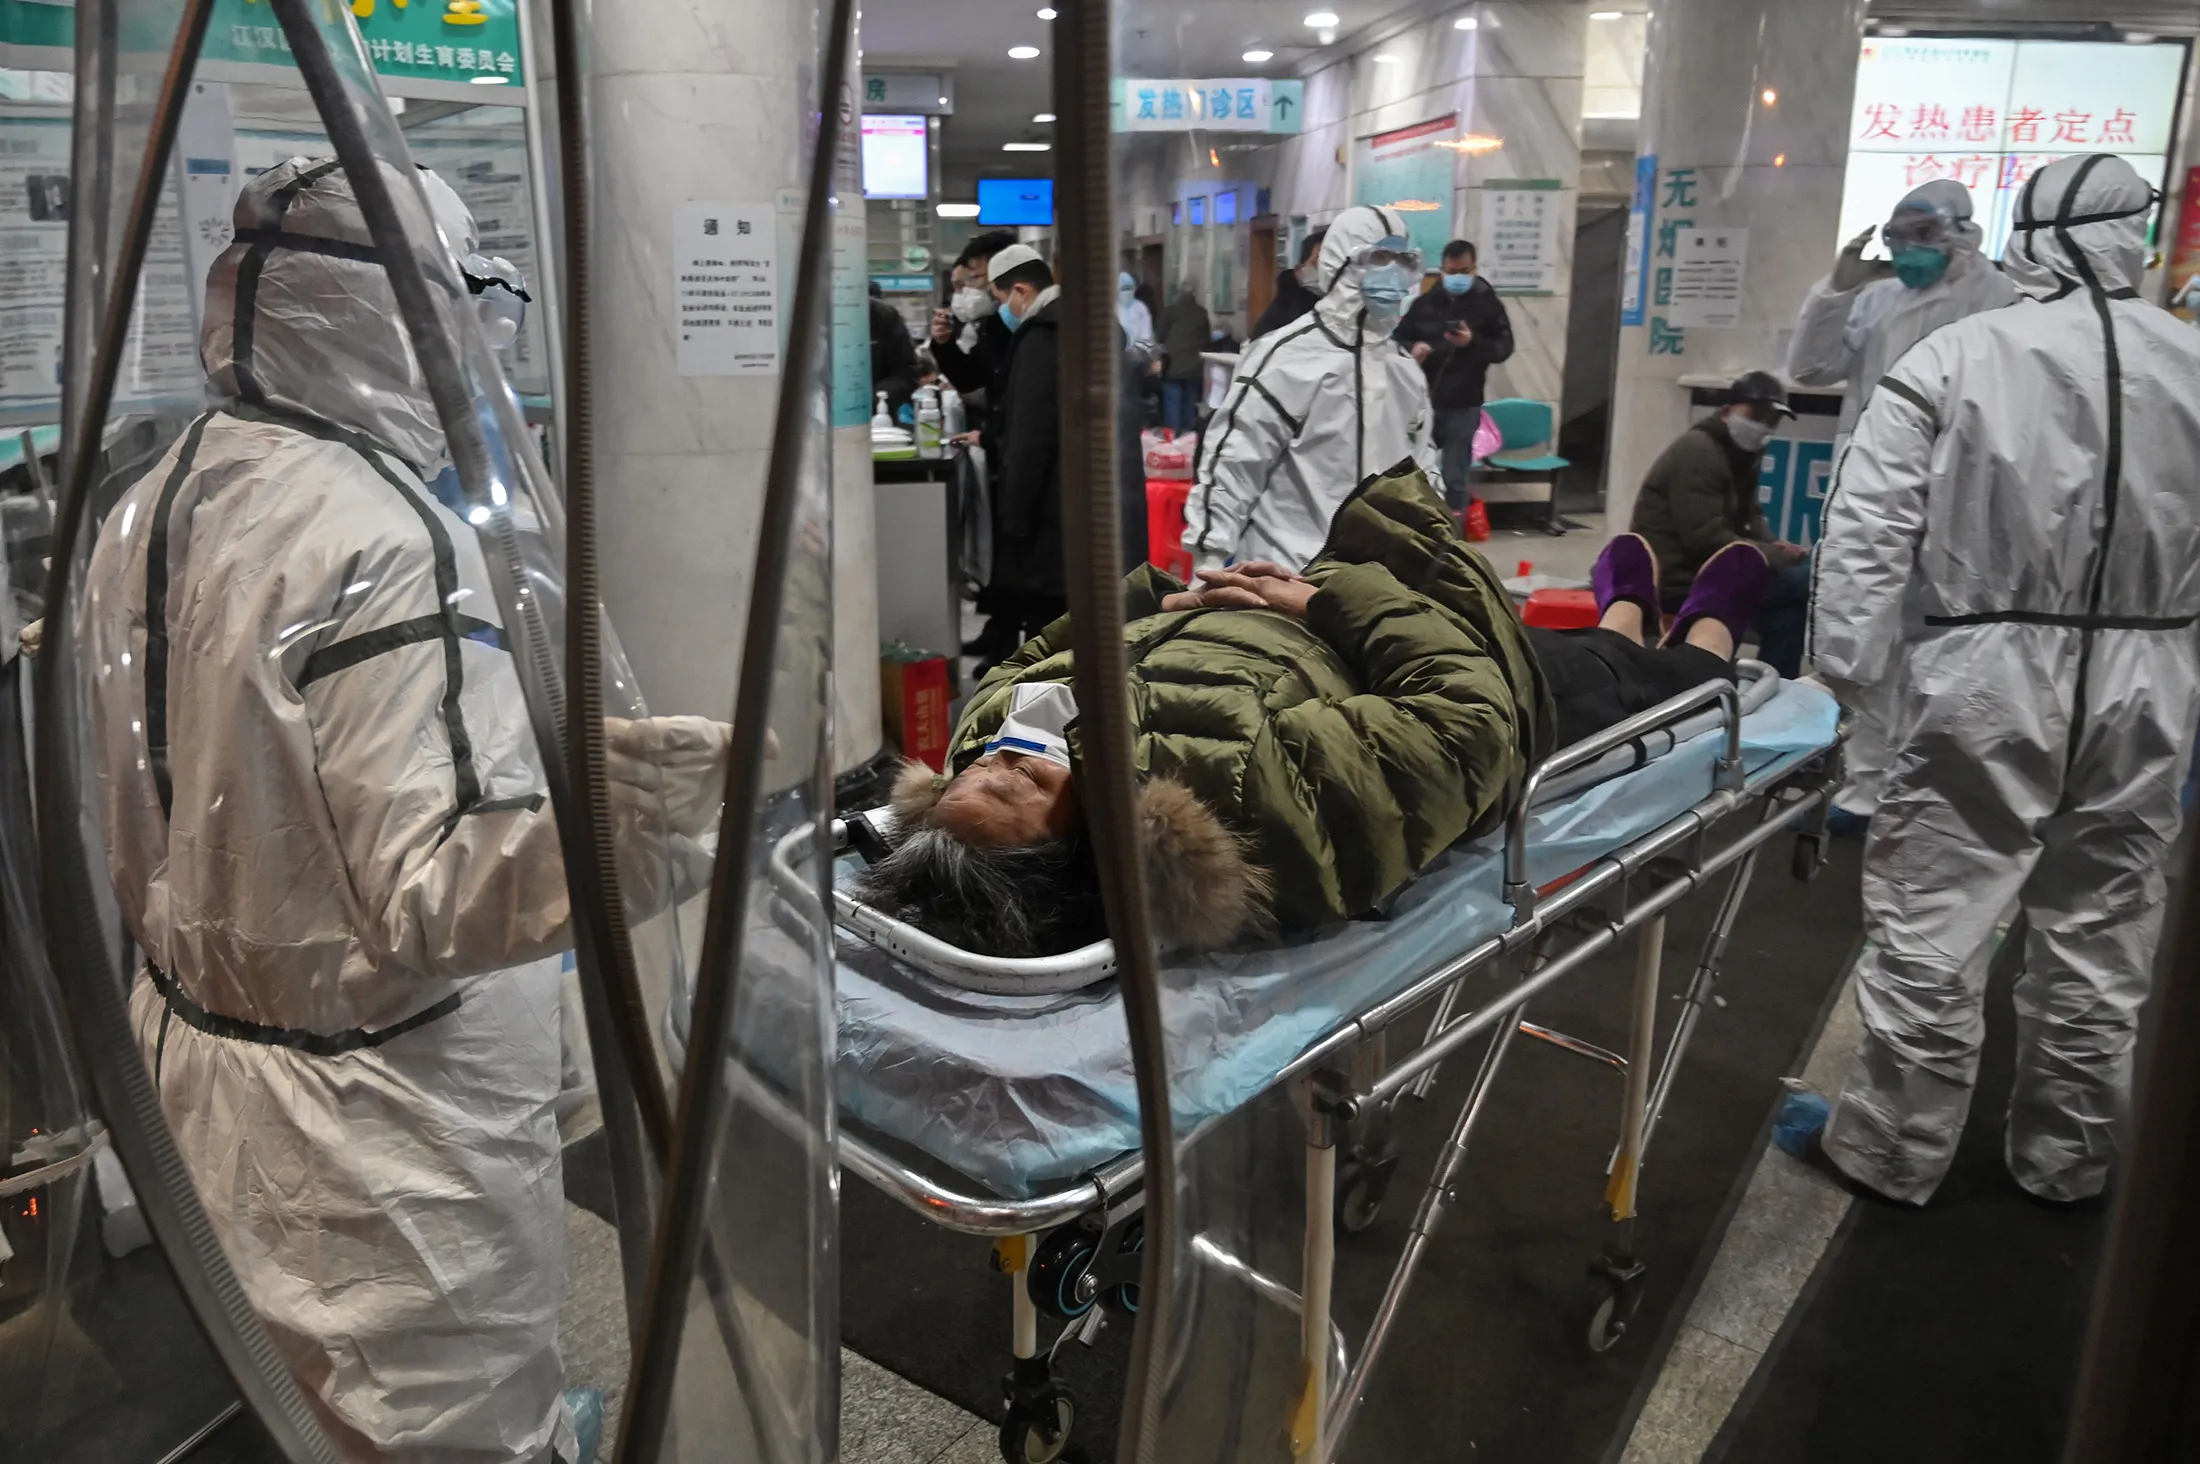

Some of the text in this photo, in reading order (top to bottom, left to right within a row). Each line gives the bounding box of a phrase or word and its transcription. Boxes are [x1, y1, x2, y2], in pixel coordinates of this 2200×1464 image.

[1137, 87, 1256, 120] 发热门诊区
[1860, 102, 2137, 145] 发热患者定点
[1903, 154, 2063, 190] 诊疗医
[703, 218, 751, 236] 通知
